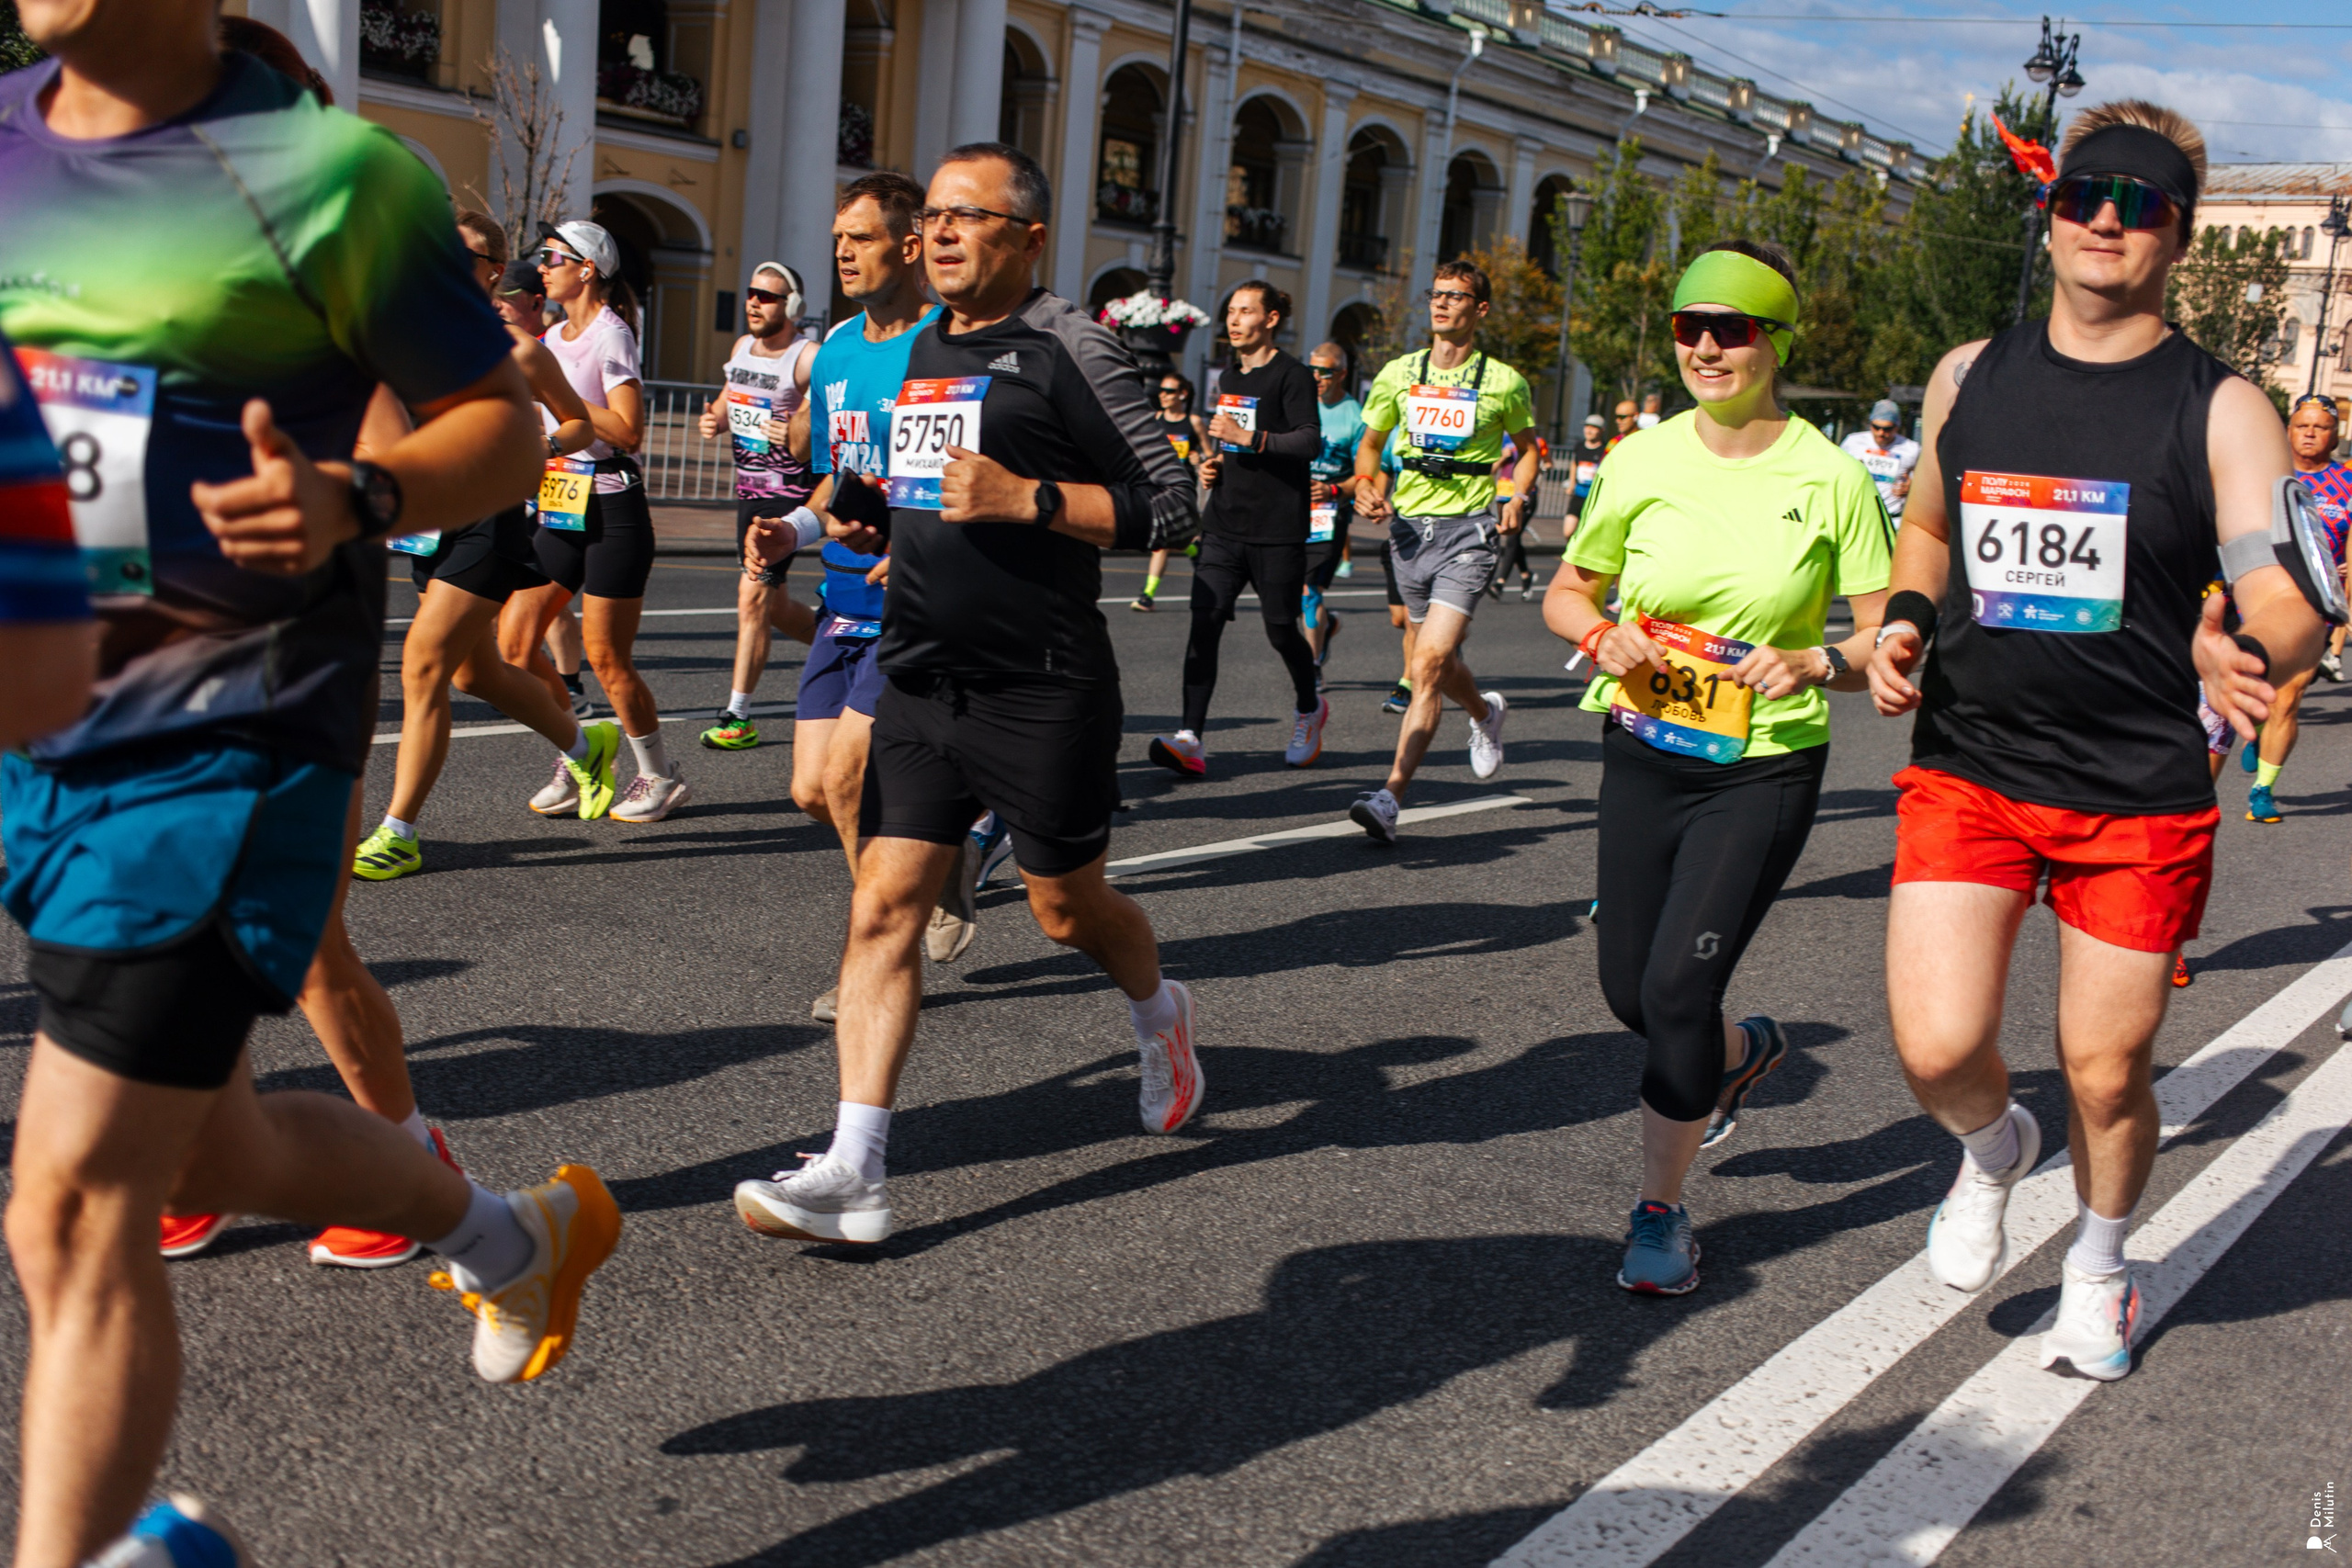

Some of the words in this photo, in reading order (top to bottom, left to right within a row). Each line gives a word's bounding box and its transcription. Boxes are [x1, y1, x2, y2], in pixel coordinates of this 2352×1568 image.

[987, 362, 1021, 374] adidas
[1416, 406, 1465, 428] 7760
[895, 413, 964, 453] 5750
[838, 442, 883, 476] 2024
[1980, 486, 2030, 498] МАРАФОН
[2052, 489, 2077, 502] 21,1
[1977, 518, 2101, 570] 6184
[2005, 570, 2066, 587] СЕРГЕЙ
[1703, 642, 1726, 656] 21,1
[1650, 659, 1722, 710] 631
[1651, 699, 1707, 723] ЛЮБОВЬ
